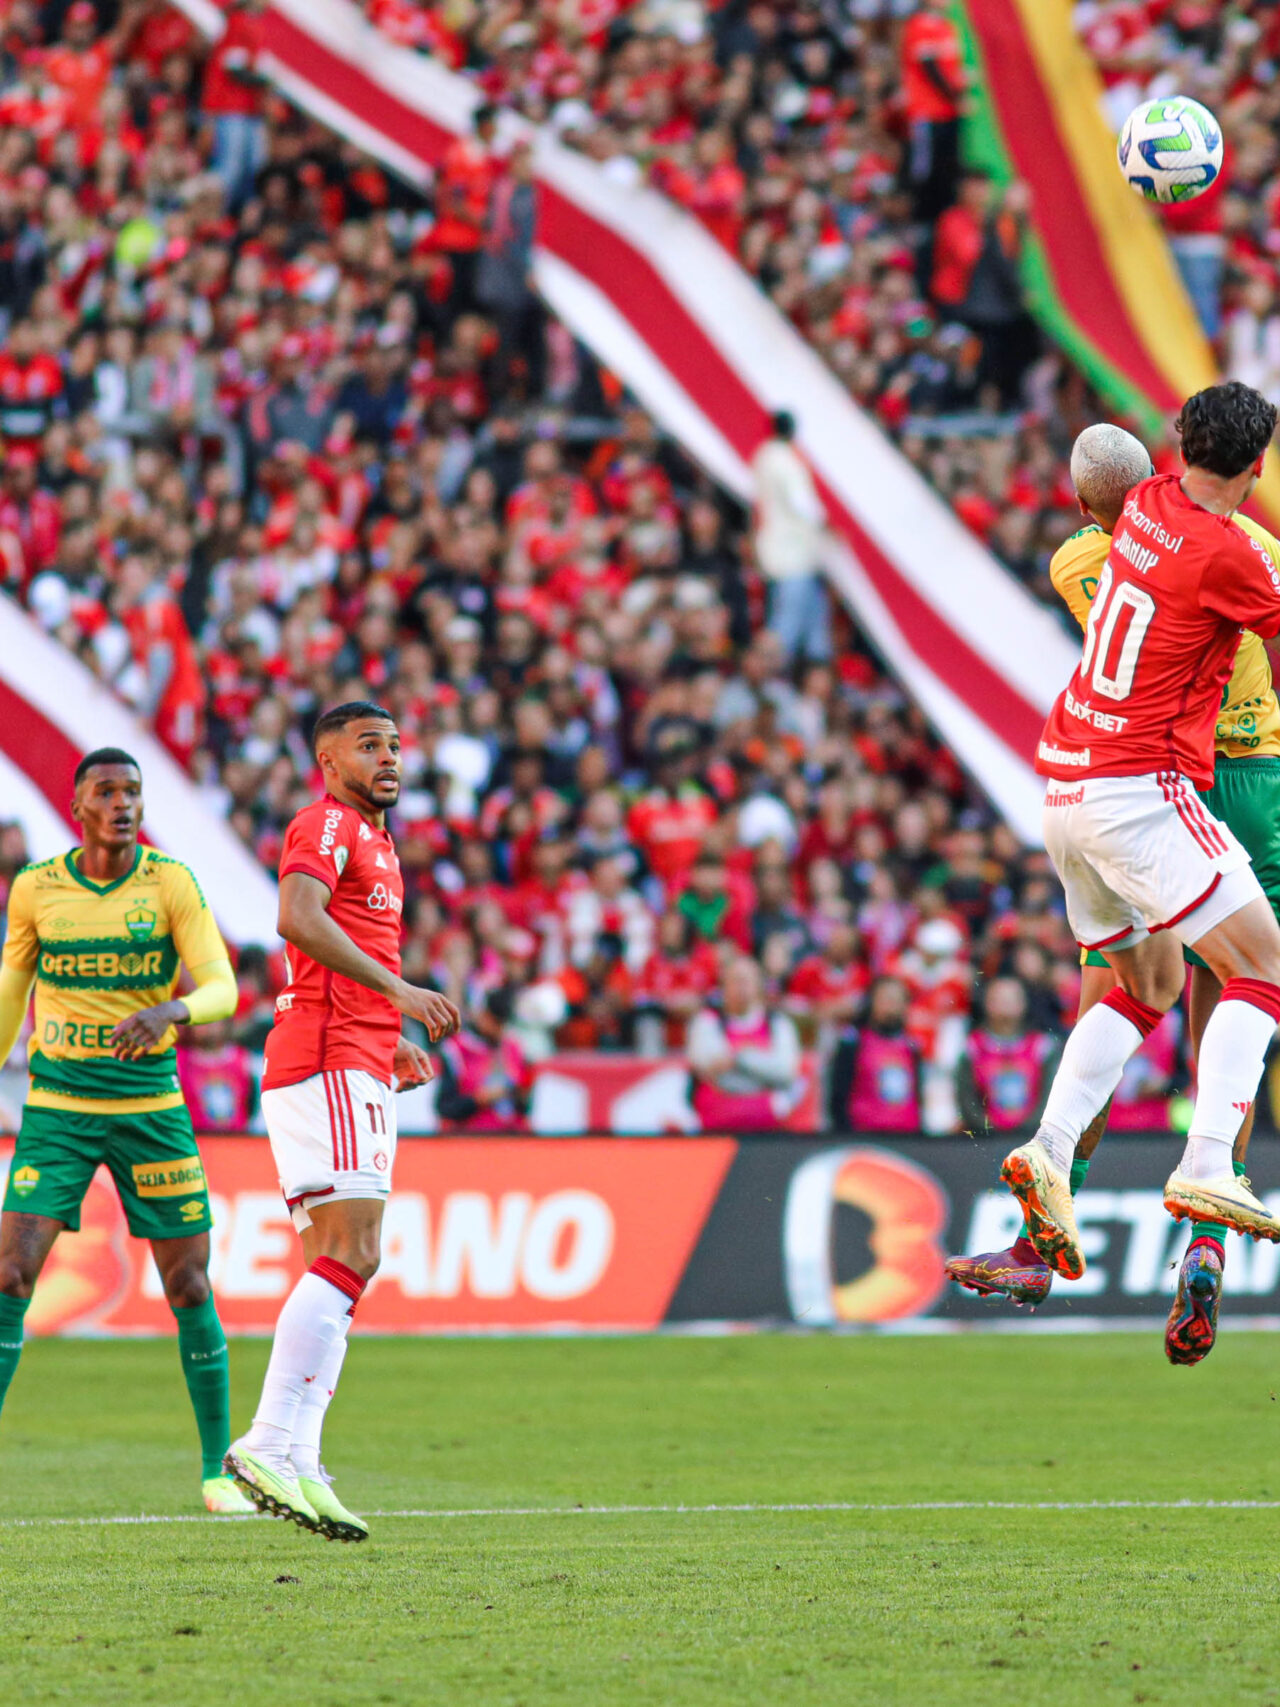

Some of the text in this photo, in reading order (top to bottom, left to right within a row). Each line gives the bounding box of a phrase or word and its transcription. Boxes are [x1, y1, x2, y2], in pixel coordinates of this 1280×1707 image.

[1080, 559, 1156, 702] 30
[1038, 741, 1091, 767] Unimed
[1044, 785, 1085, 807] nimed
[319, 817, 341, 856] vero
[40, 951, 163, 977] DREBOR
[43, 1020, 158, 1049] DREB
[365, 1102, 387, 1135] 11
[141, 1189, 614, 1298] EANO
